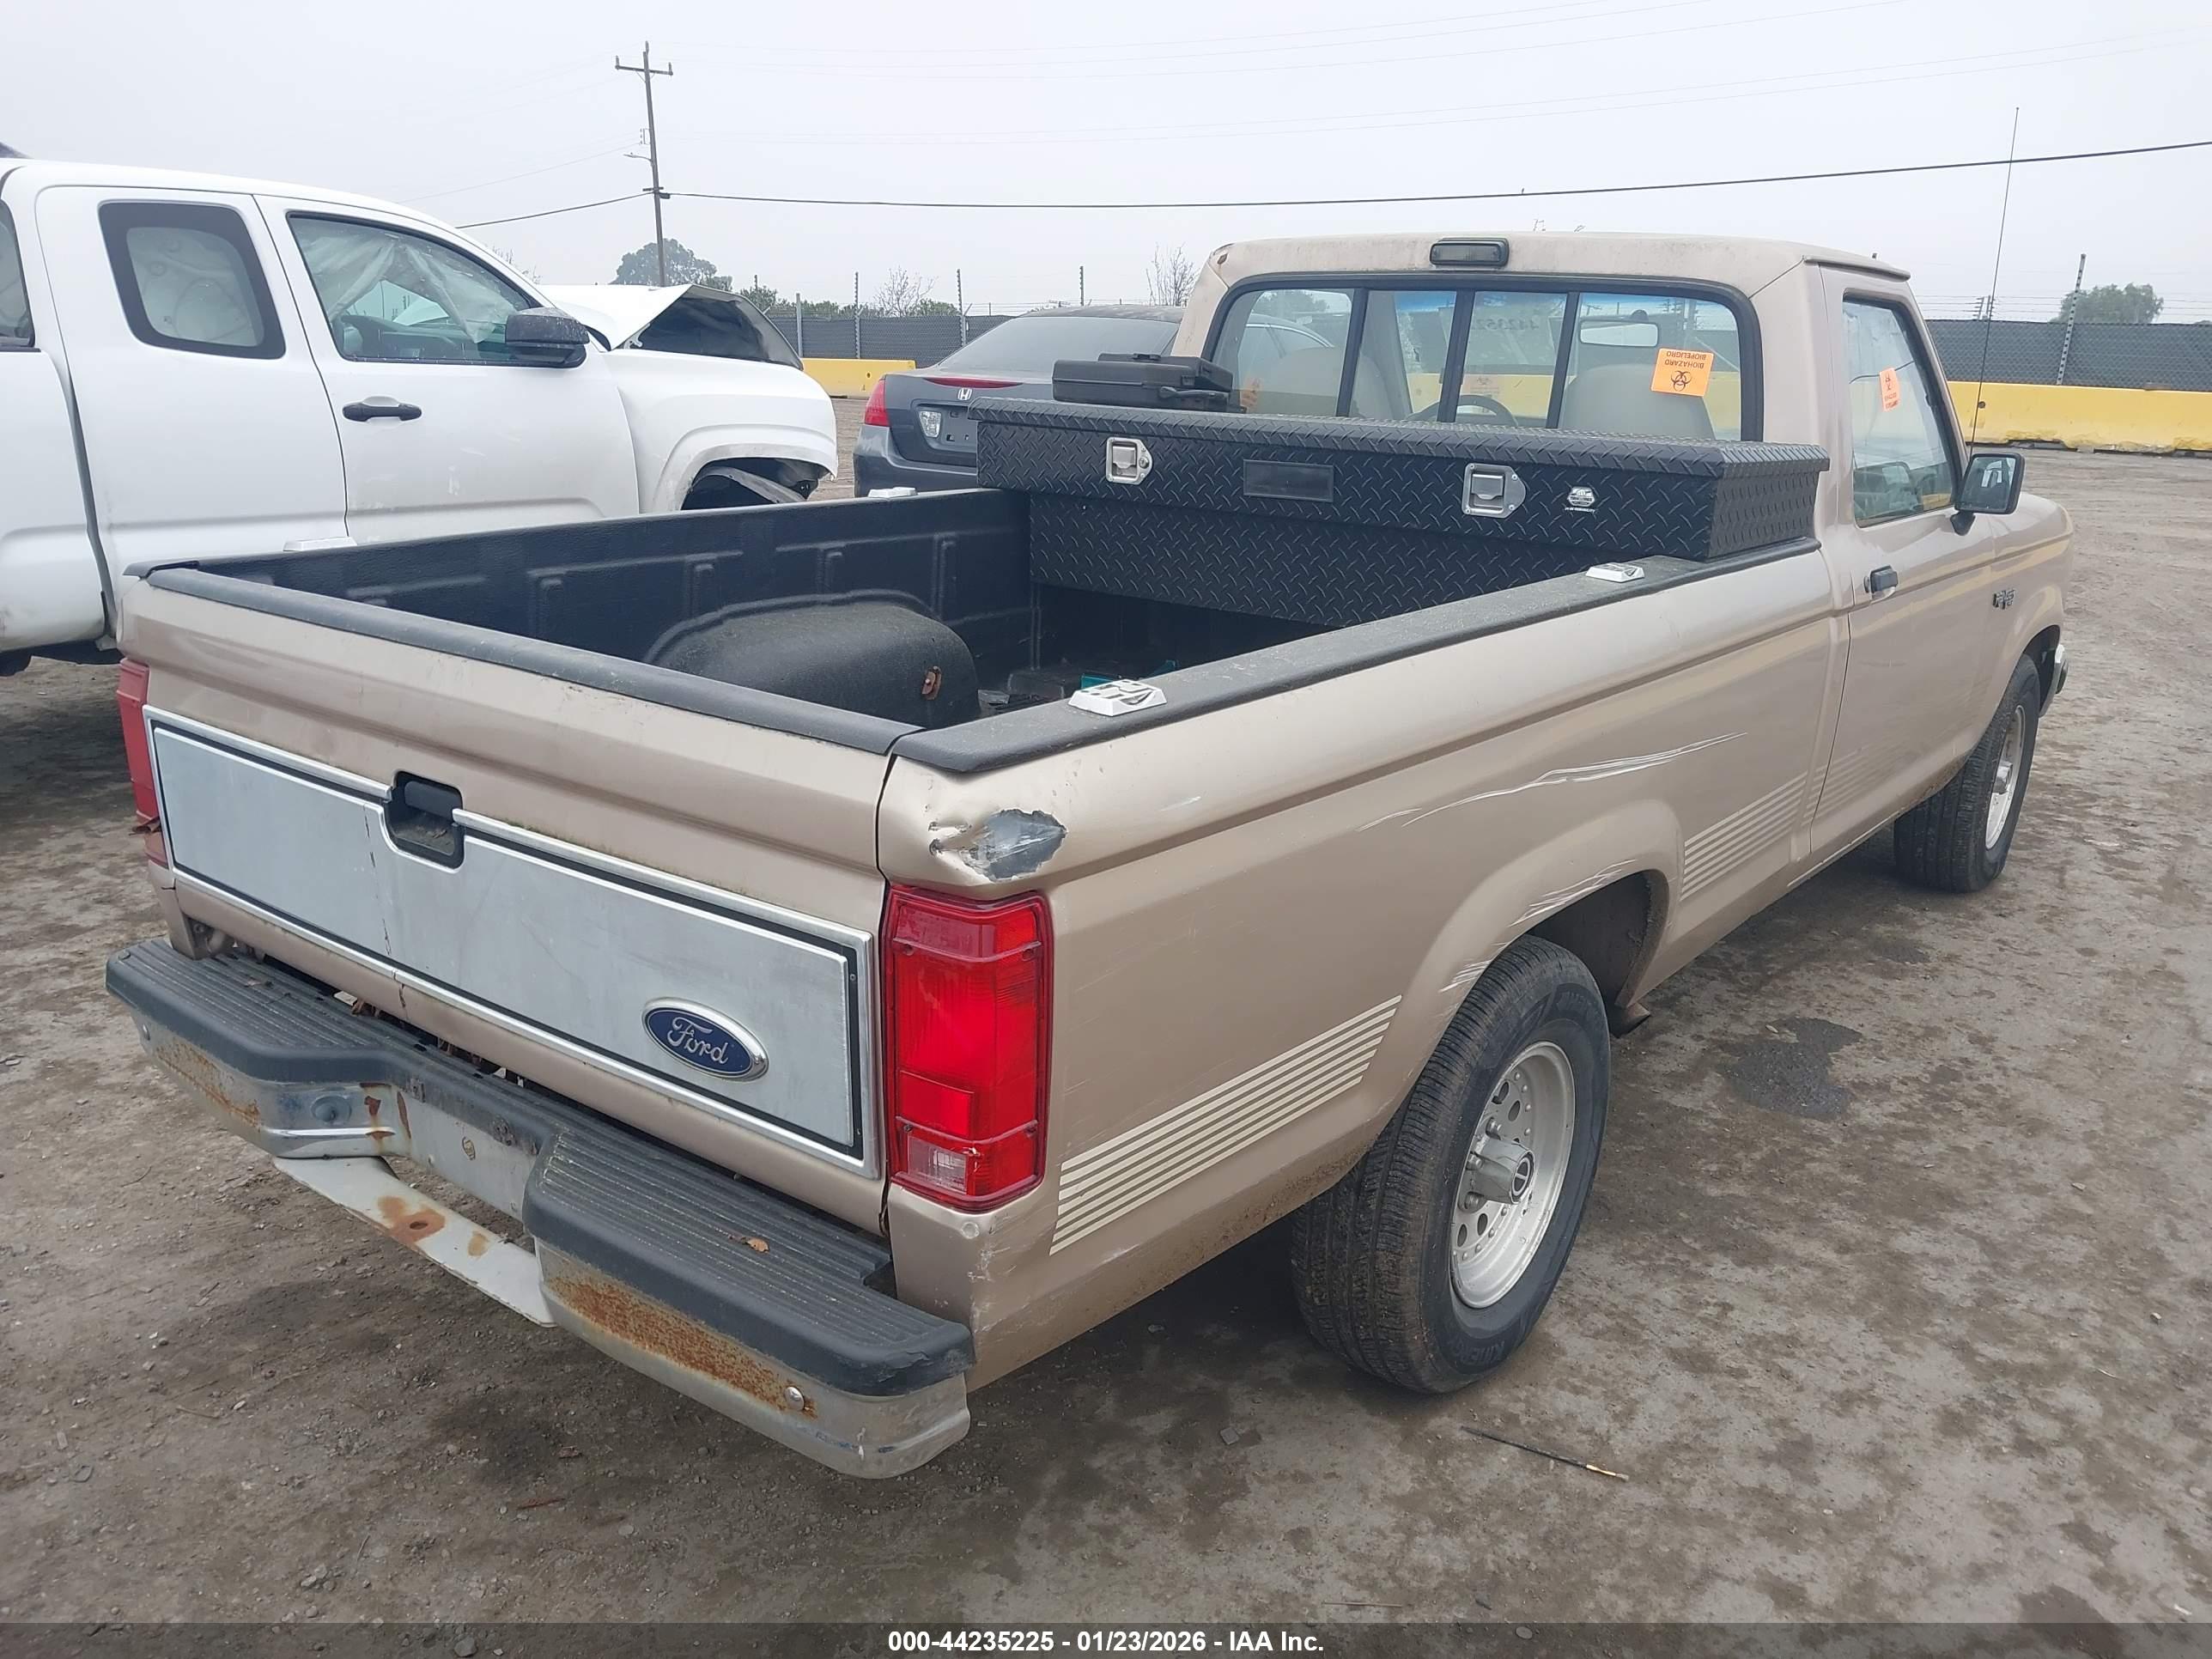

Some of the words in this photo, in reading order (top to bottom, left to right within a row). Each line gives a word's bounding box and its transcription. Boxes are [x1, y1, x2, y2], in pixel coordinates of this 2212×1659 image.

[1666, 350, 1706, 361] BIOPELIGRO
[1664, 359, 1705, 368] BIOHAZARD
[666, 1017, 728, 1065] Ford
